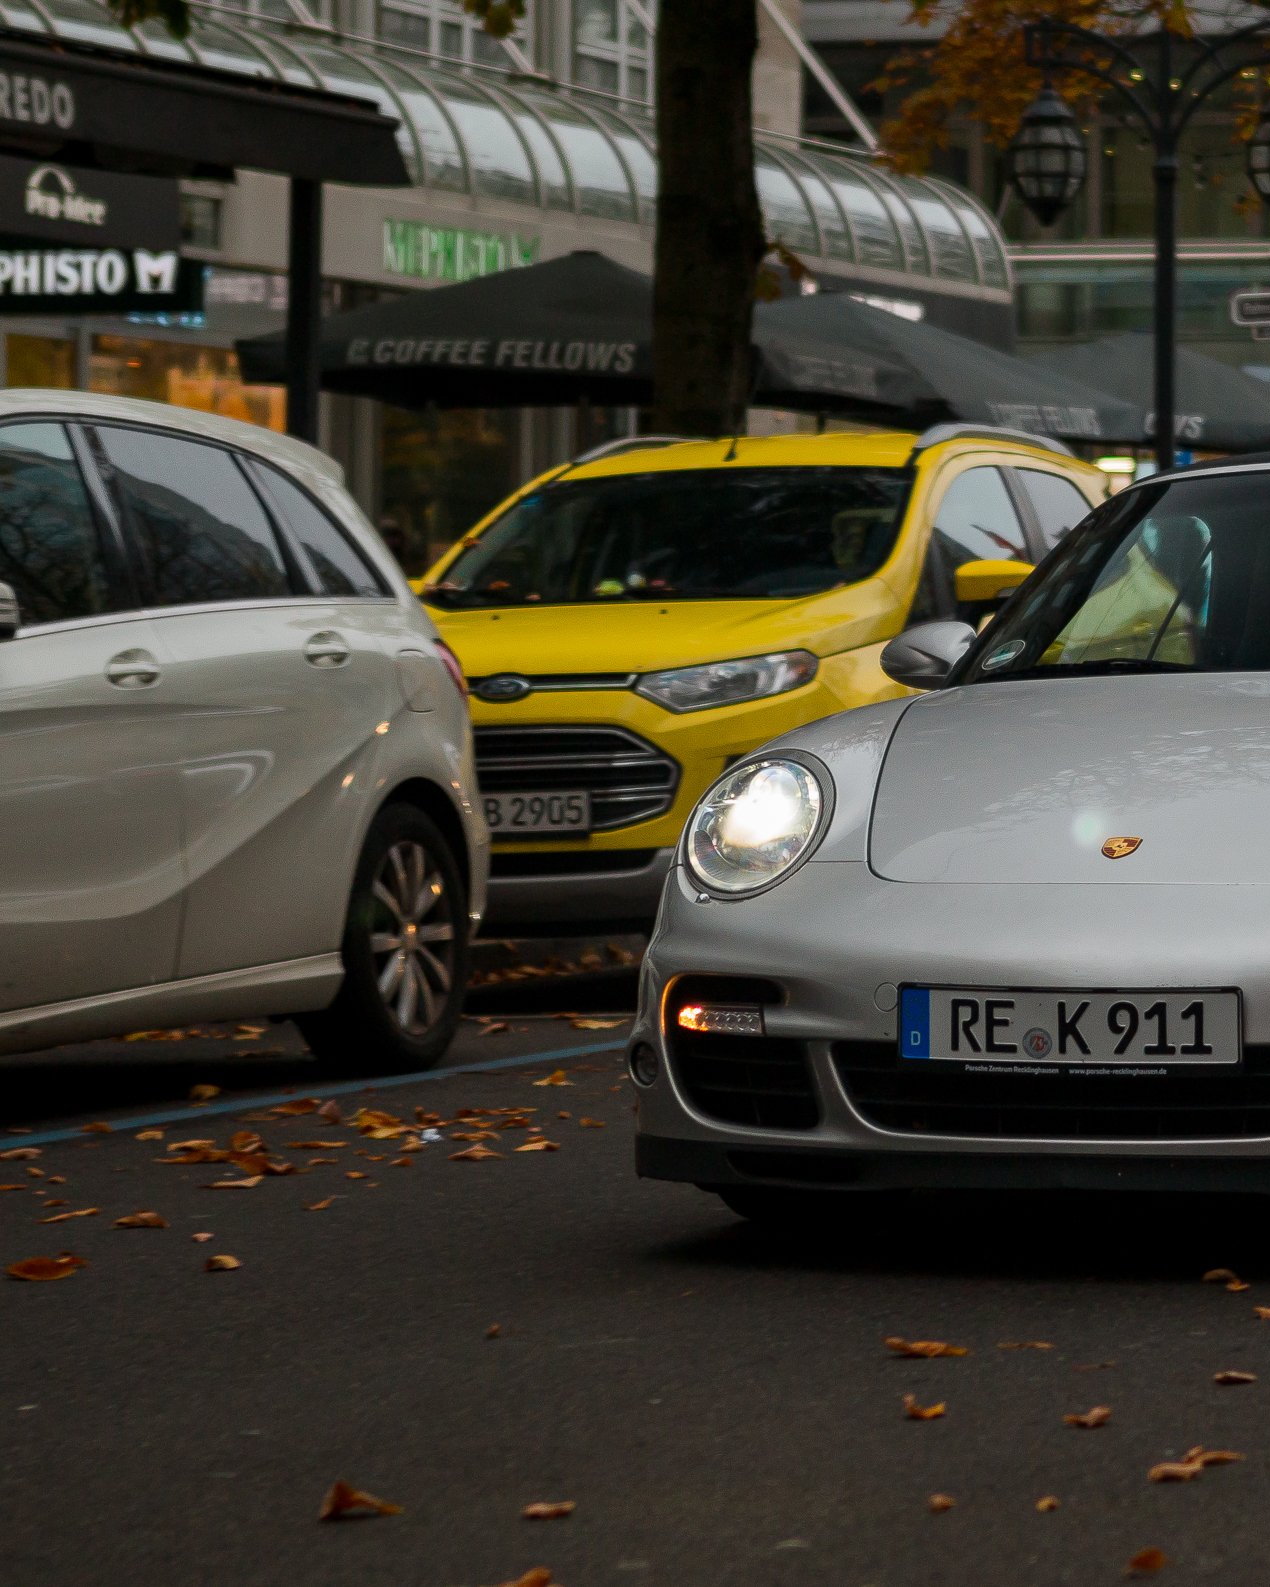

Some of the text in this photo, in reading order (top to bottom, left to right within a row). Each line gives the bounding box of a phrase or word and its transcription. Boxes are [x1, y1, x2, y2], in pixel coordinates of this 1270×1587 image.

[373, 340, 637, 373] COFFEE FELLOWS
[511, 795, 582, 825] 2905
[910, 998, 1213, 1055] D RE K 911
[965, 1064, 1167, 1076] Porsche Zentrum Recklinghausen www.porsche-recklinghausen.de
